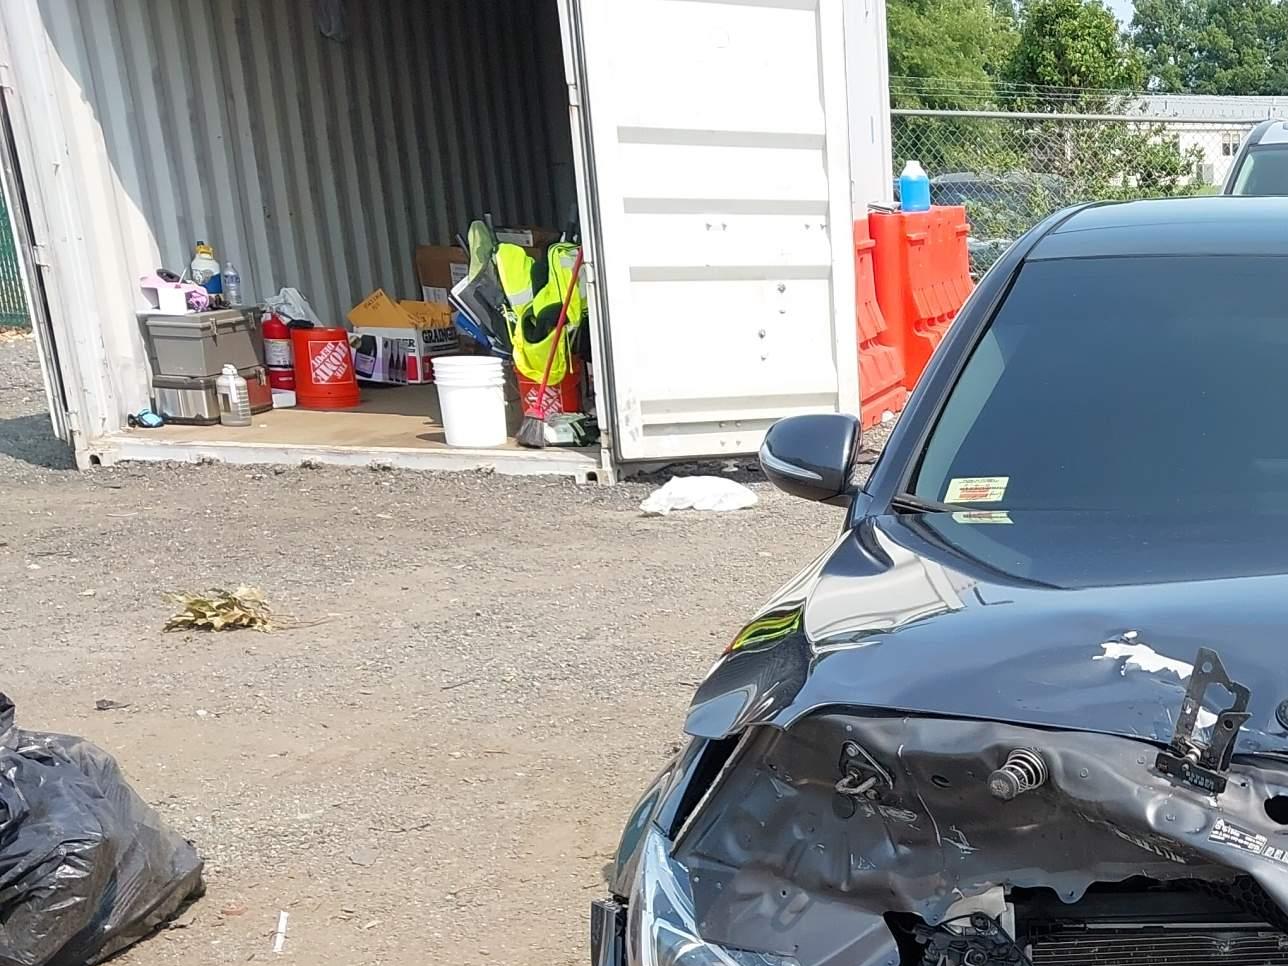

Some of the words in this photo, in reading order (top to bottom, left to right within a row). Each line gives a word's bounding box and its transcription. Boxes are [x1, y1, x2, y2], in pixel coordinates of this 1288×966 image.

[310, 342, 335, 368] DEPOT
[312, 342, 349, 385] HOME
[333, 362, 348, 379] THE
